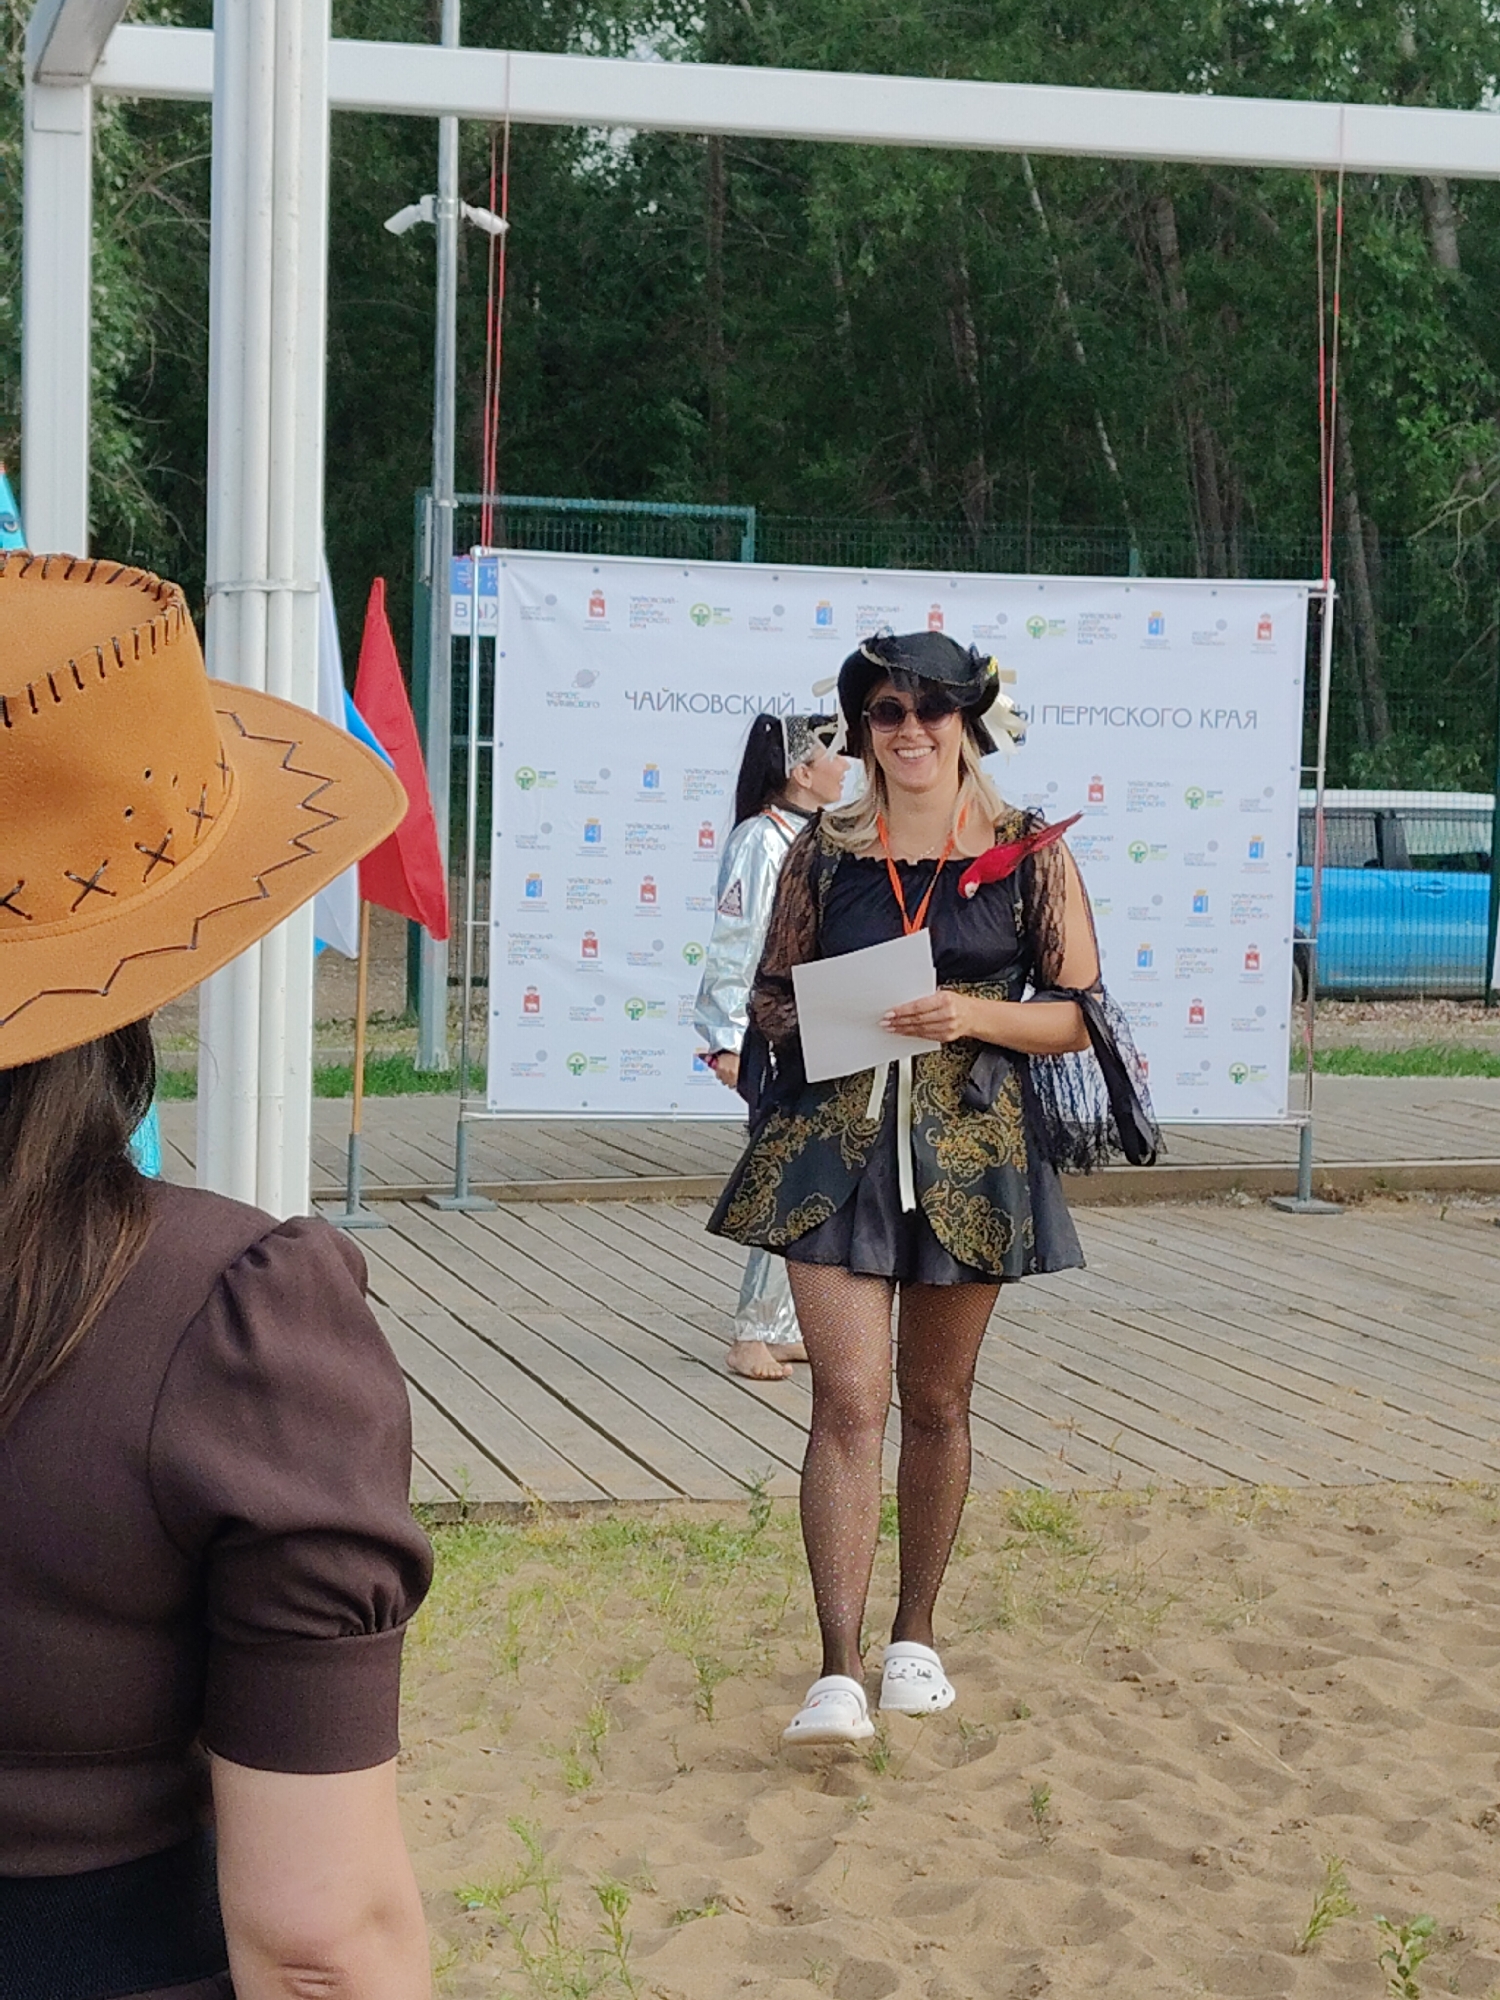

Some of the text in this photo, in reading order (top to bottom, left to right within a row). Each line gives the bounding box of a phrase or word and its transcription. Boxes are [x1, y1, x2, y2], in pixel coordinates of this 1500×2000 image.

[624, 687, 795, 716] ЧАЙКОВСКИЙ
[1042, 704, 1192, 729] ПЕРМСКОГО
[1200, 708, 1257, 730] КРАЯ
